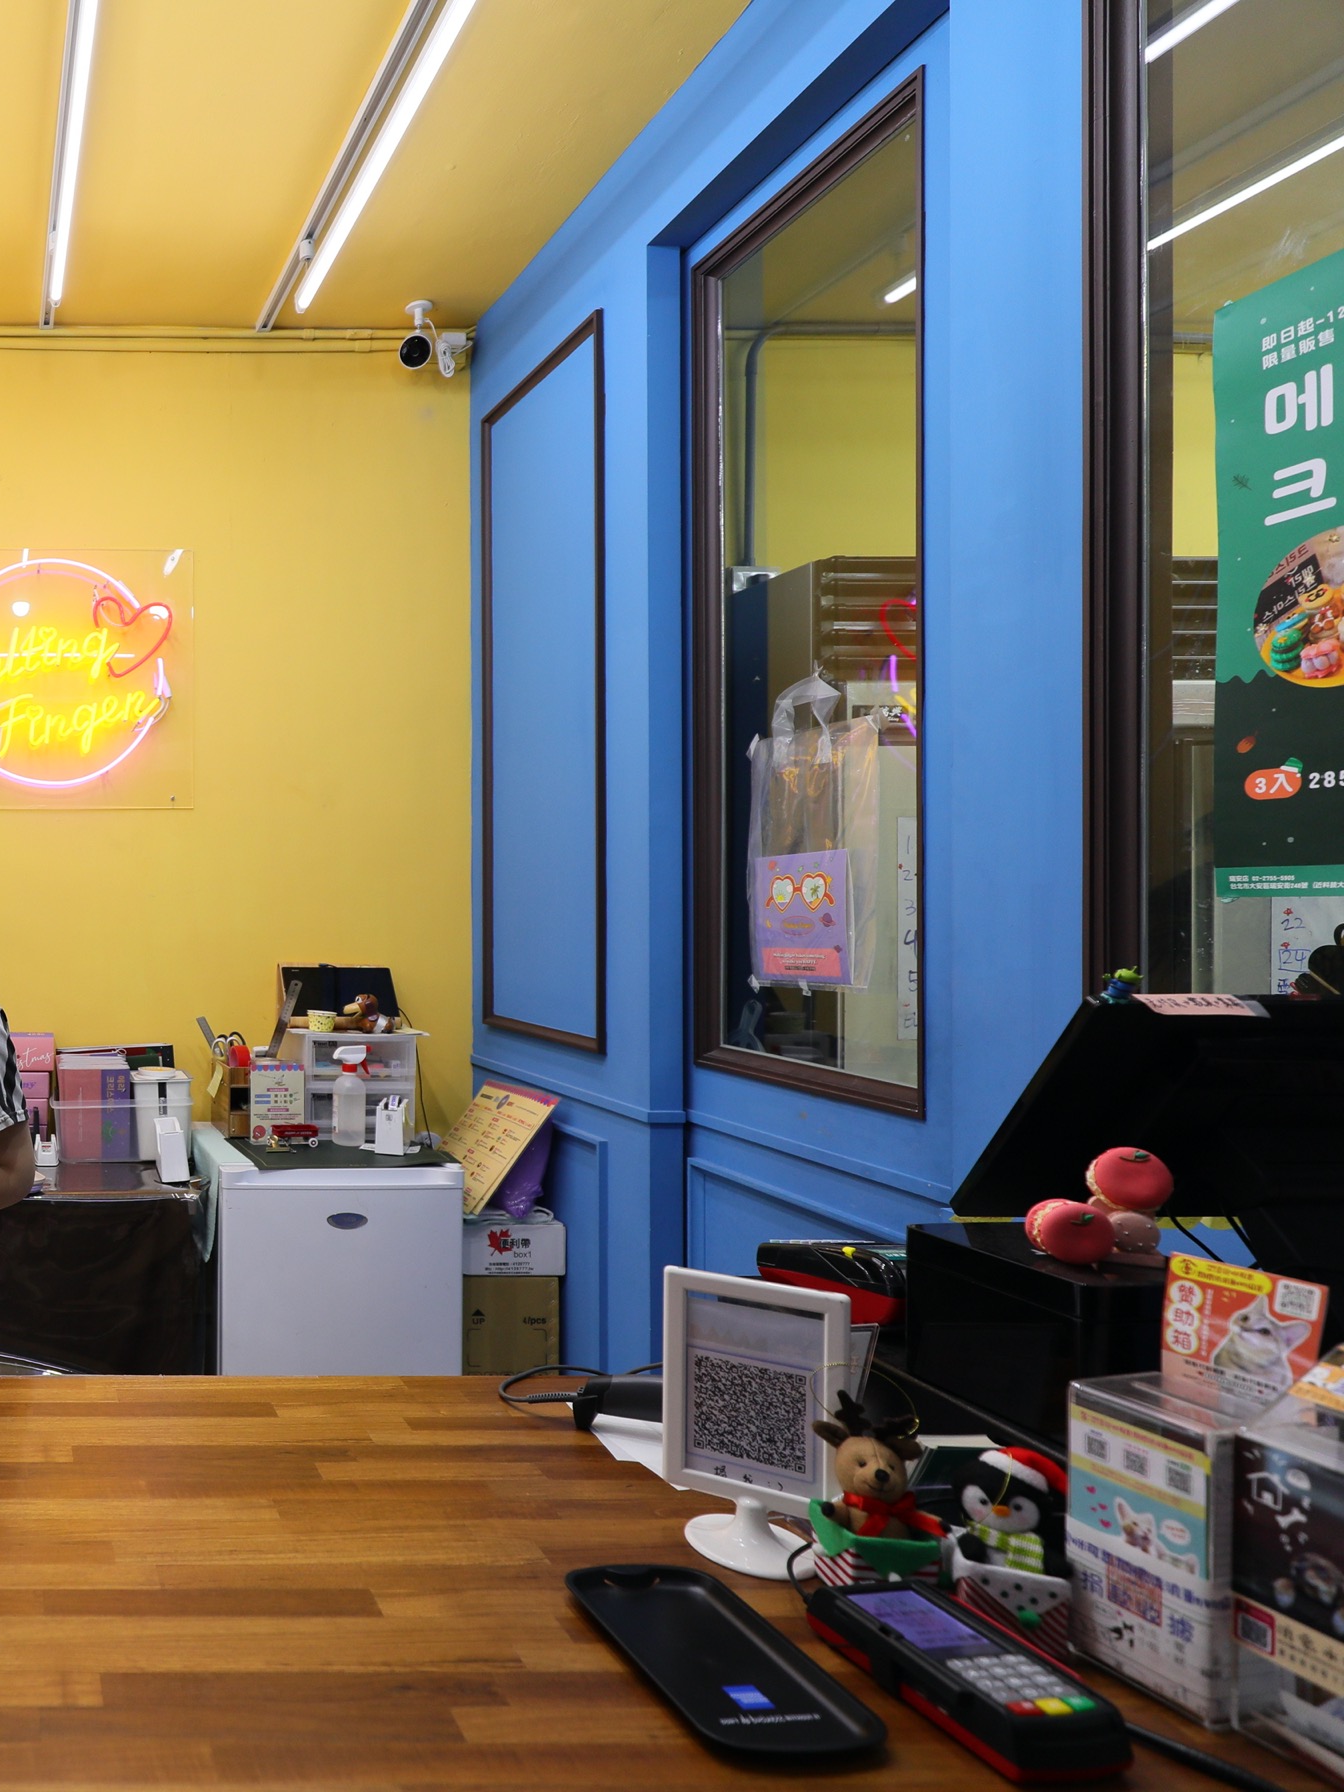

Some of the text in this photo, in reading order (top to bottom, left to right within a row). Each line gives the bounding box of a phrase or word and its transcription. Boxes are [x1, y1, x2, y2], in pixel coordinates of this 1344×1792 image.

[1262, 328, 1335, 370] 限量販售
[1264, 363, 1334, 435] 에
[1264, 458, 1337, 526] 크
[1254, 773, 1293, 794] 3入
[16, 1047, 54, 1070] istmas
[500, 1238, 531, 1249] 便利帶
[513, 1250, 532, 1259] box1
